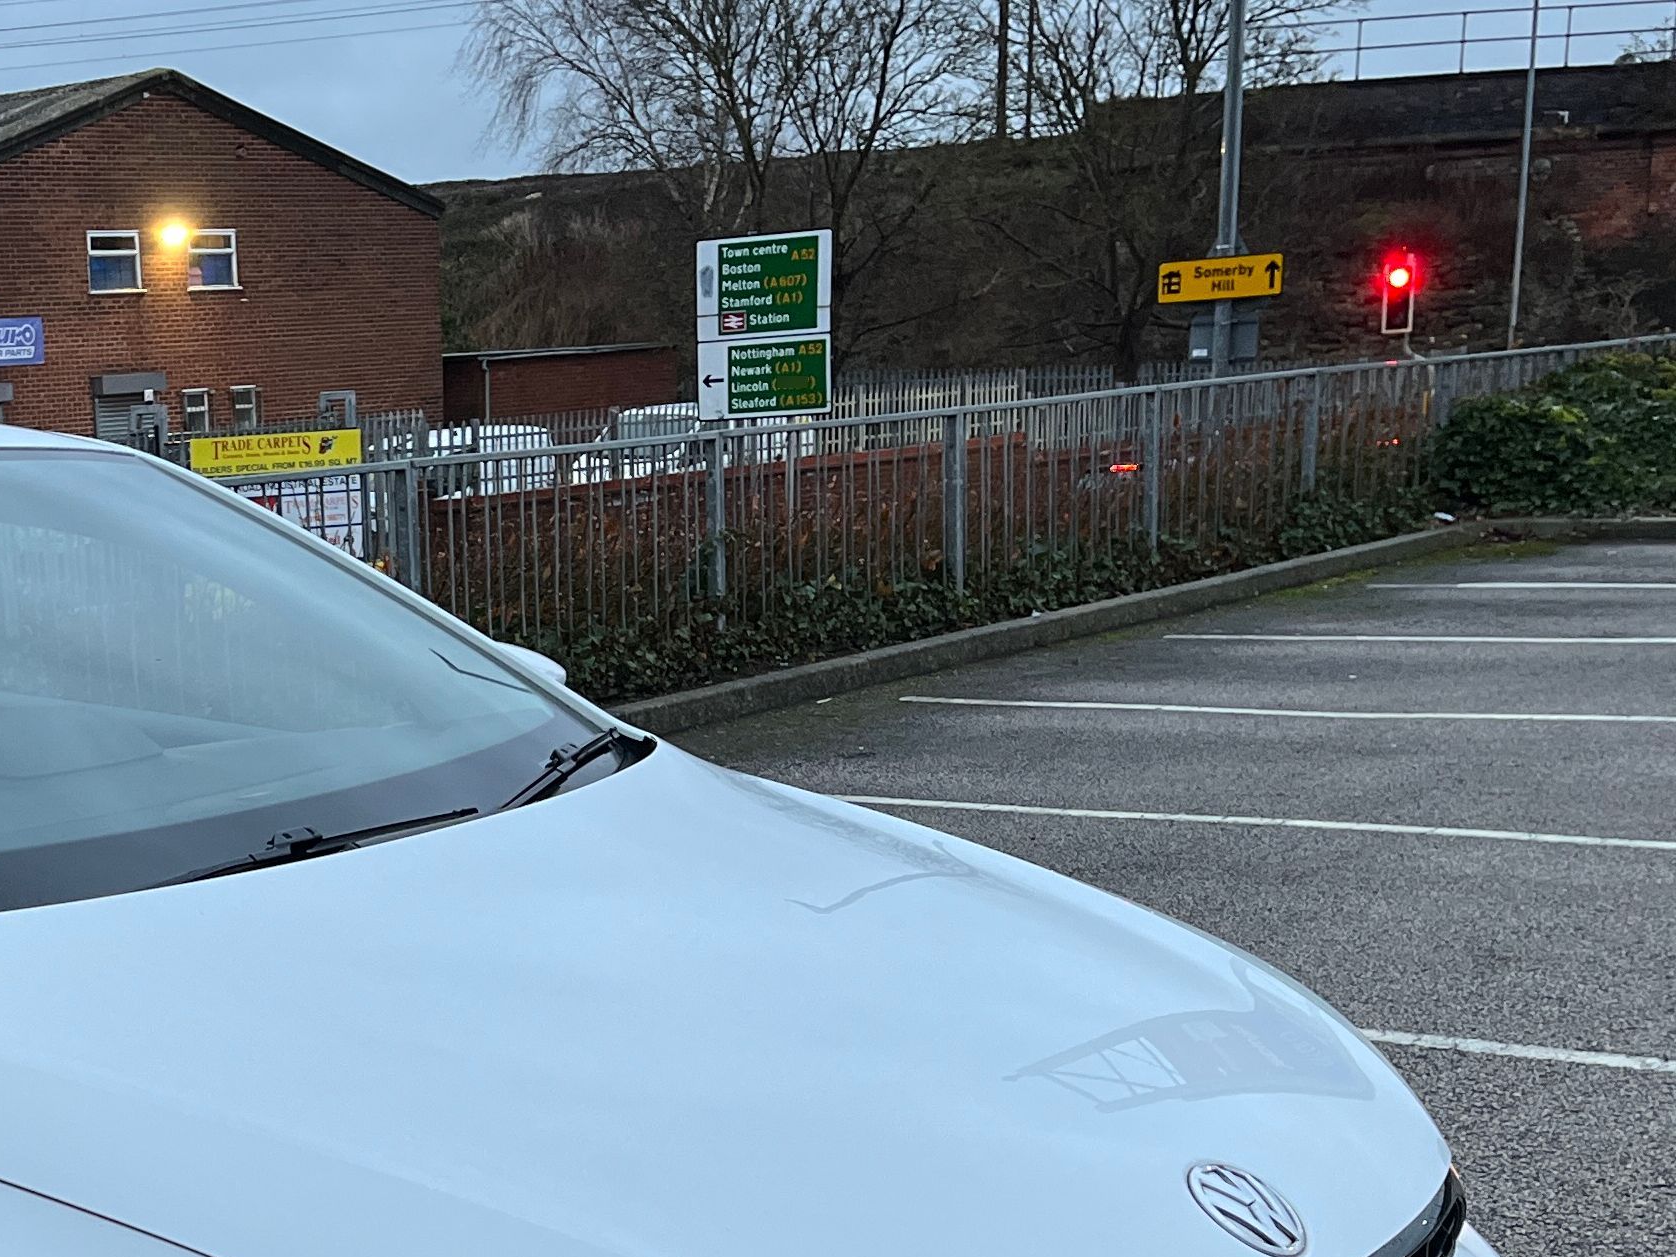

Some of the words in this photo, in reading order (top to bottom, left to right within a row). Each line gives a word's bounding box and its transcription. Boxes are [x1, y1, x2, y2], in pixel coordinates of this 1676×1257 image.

[721, 246, 750, 259] Town
[752, 243, 789, 256] centre
[791, 248, 816, 260] A52
[721, 263, 762, 276] Boston
[1193, 263, 1255, 279] Somerby
[721, 279, 761, 292] Melton
[721, 293, 773, 309] Stamford
[775, 290, 804, 305] (A1)
[749, 312, 790, 326] Station
[5, 347, 33, 357] PARTS
[731, 346, 795, 361] Nottingham
[798, 343, 823, 355] A52
[731, 363, 773, 377] Newark
[731, 380, 770, 393] Lincoln
[731, 395, 777, 410] Sleaford
[212, 438, 254, 460] TRADE
[257, 435, 312, 455] CARPETS
[236, 463, 269, 473] SPECIAL
[272, 461, 296, 470] FROM
[322, 475, 357, 487] ESTAE
